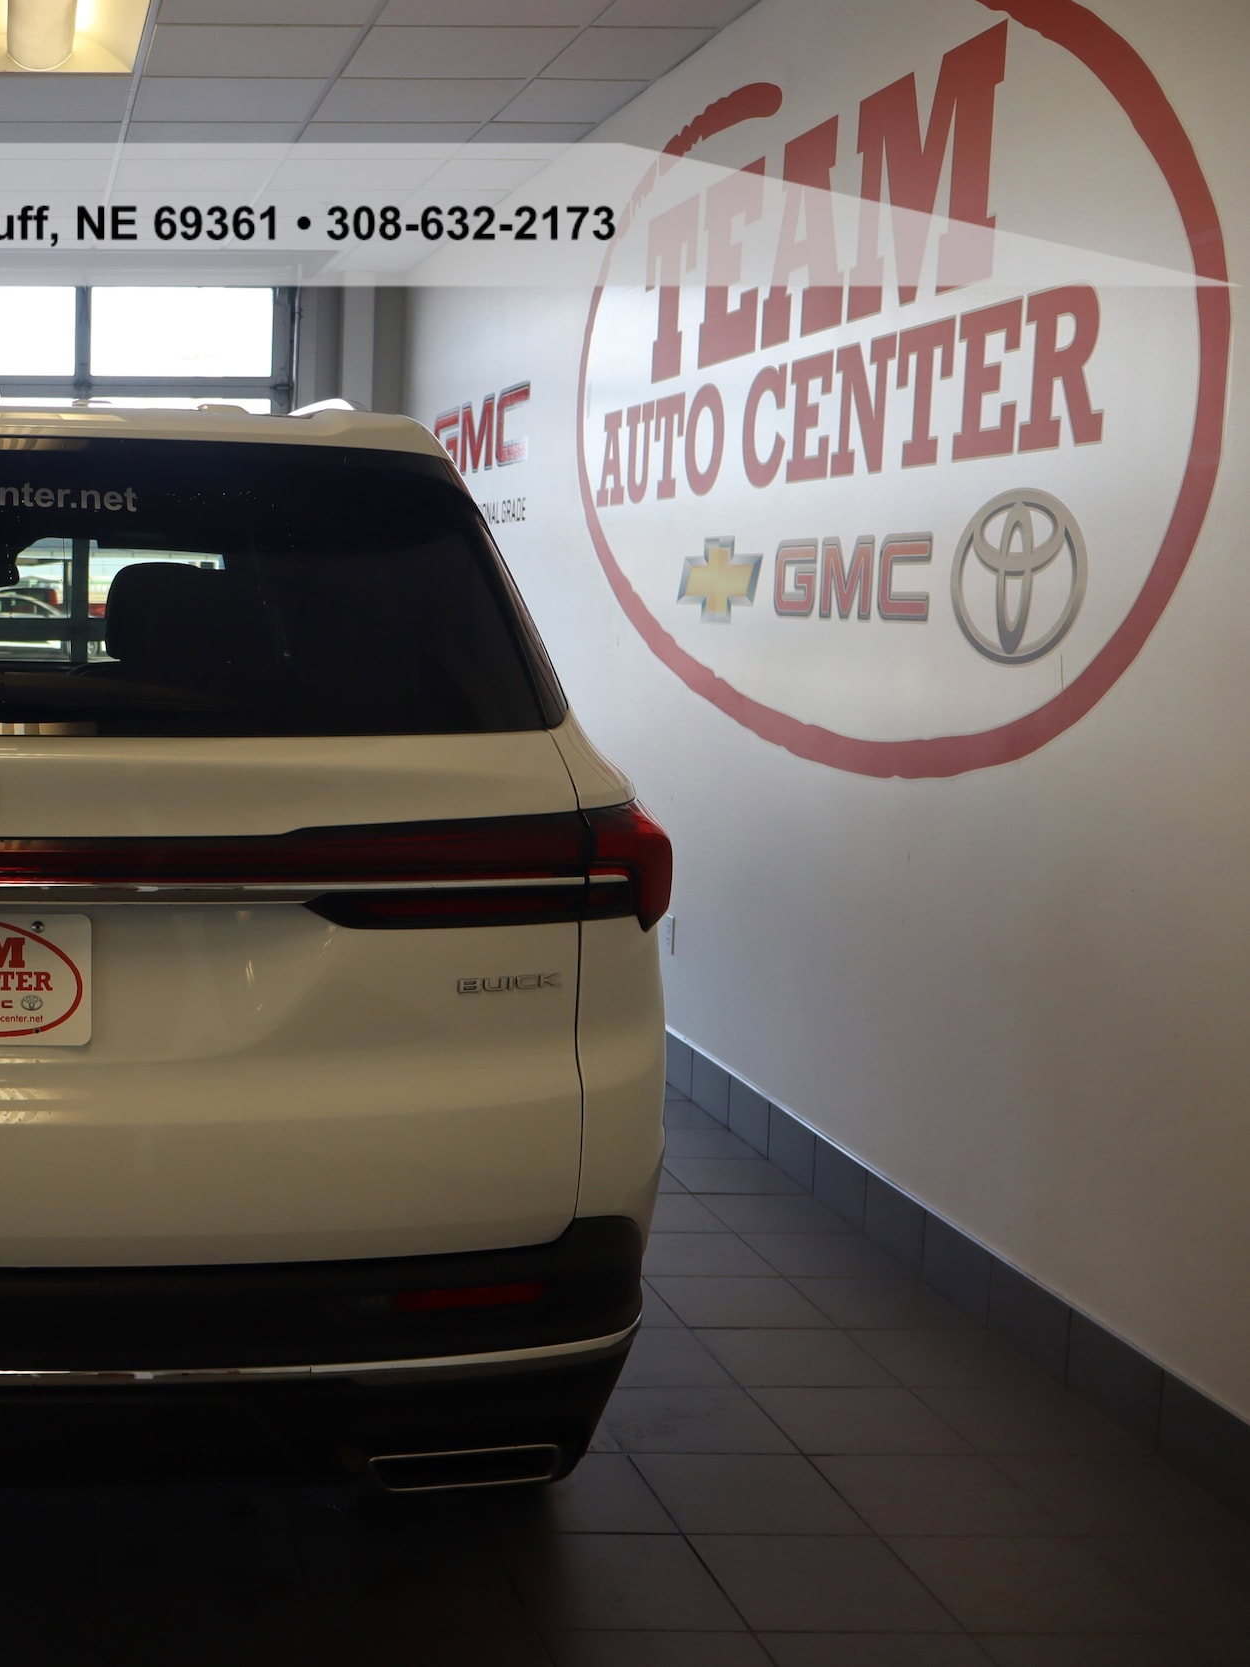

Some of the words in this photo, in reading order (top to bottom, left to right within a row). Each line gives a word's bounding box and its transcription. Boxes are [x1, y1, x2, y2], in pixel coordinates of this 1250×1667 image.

[644, 18, 1008, 385] TEAM
[596, 382, 725, 508] AUTO
[741, 282, 1104, 489] CENTER
[502, 497, 526, 523] GRADE
[772, 531, 934, 624] GMC
[456, 972, 561, 994] BUICK
